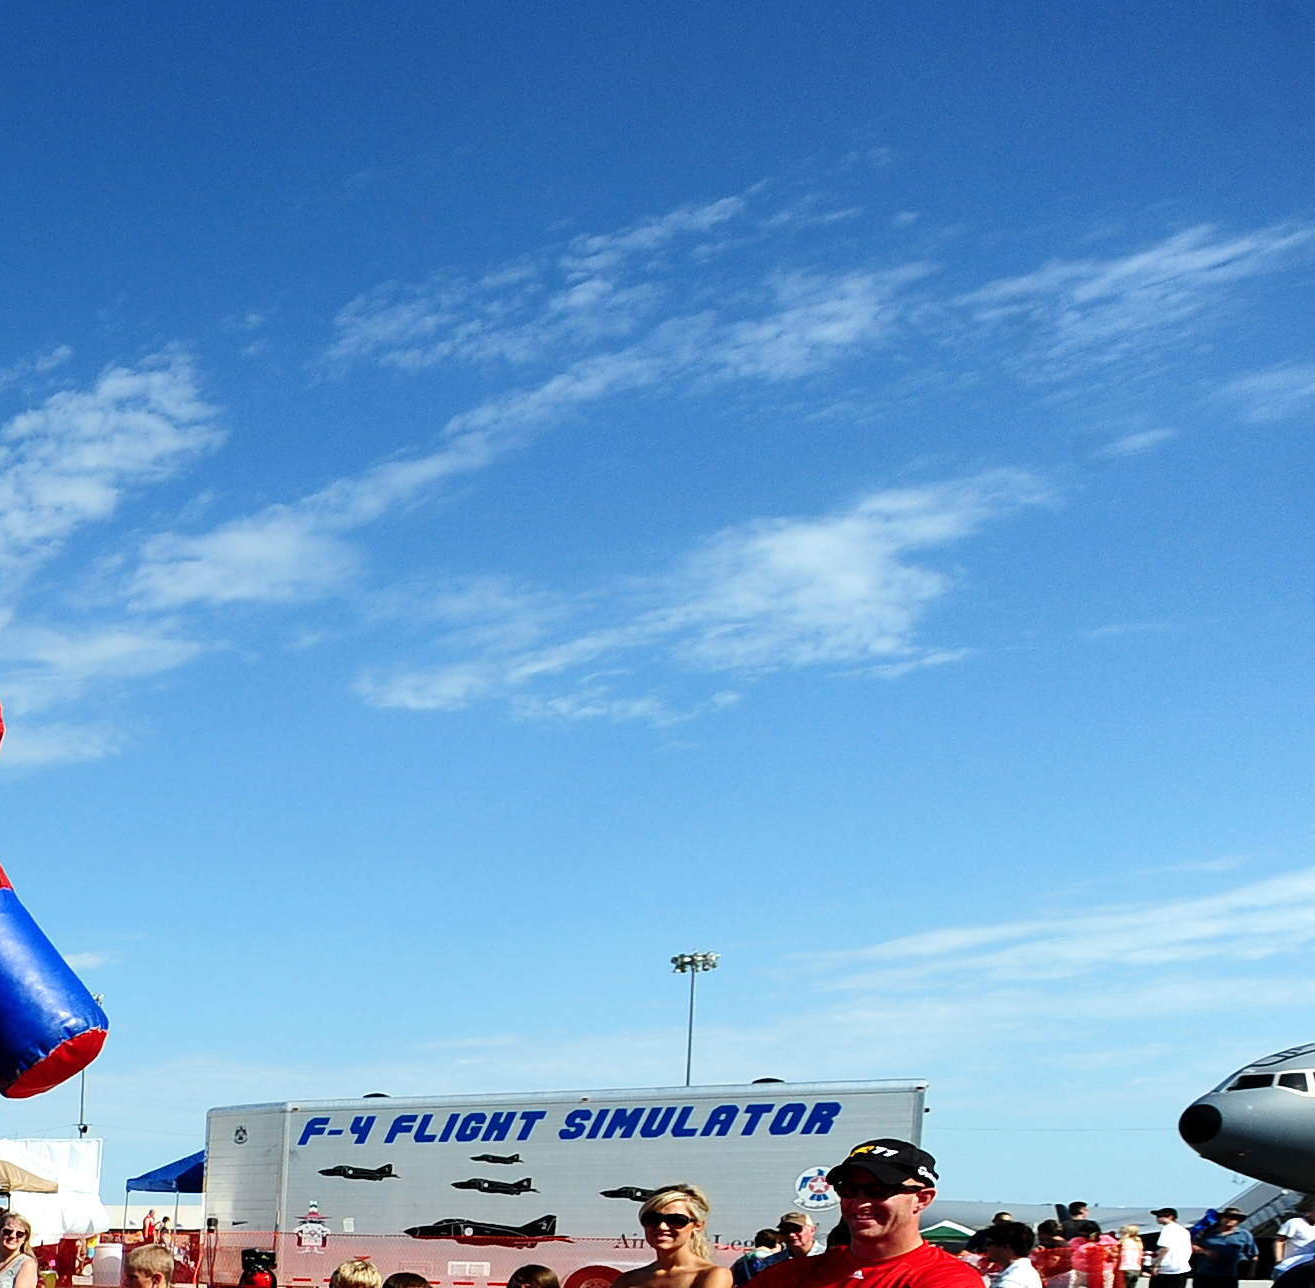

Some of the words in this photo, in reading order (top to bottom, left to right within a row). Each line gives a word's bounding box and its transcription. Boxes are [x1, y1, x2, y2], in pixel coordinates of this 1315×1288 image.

[297, 1115, 376, 1145] F-4
[383, 1110, 547, 1144] FLIGHT
[558, 1101, 843, 1140] SIMULATOR
